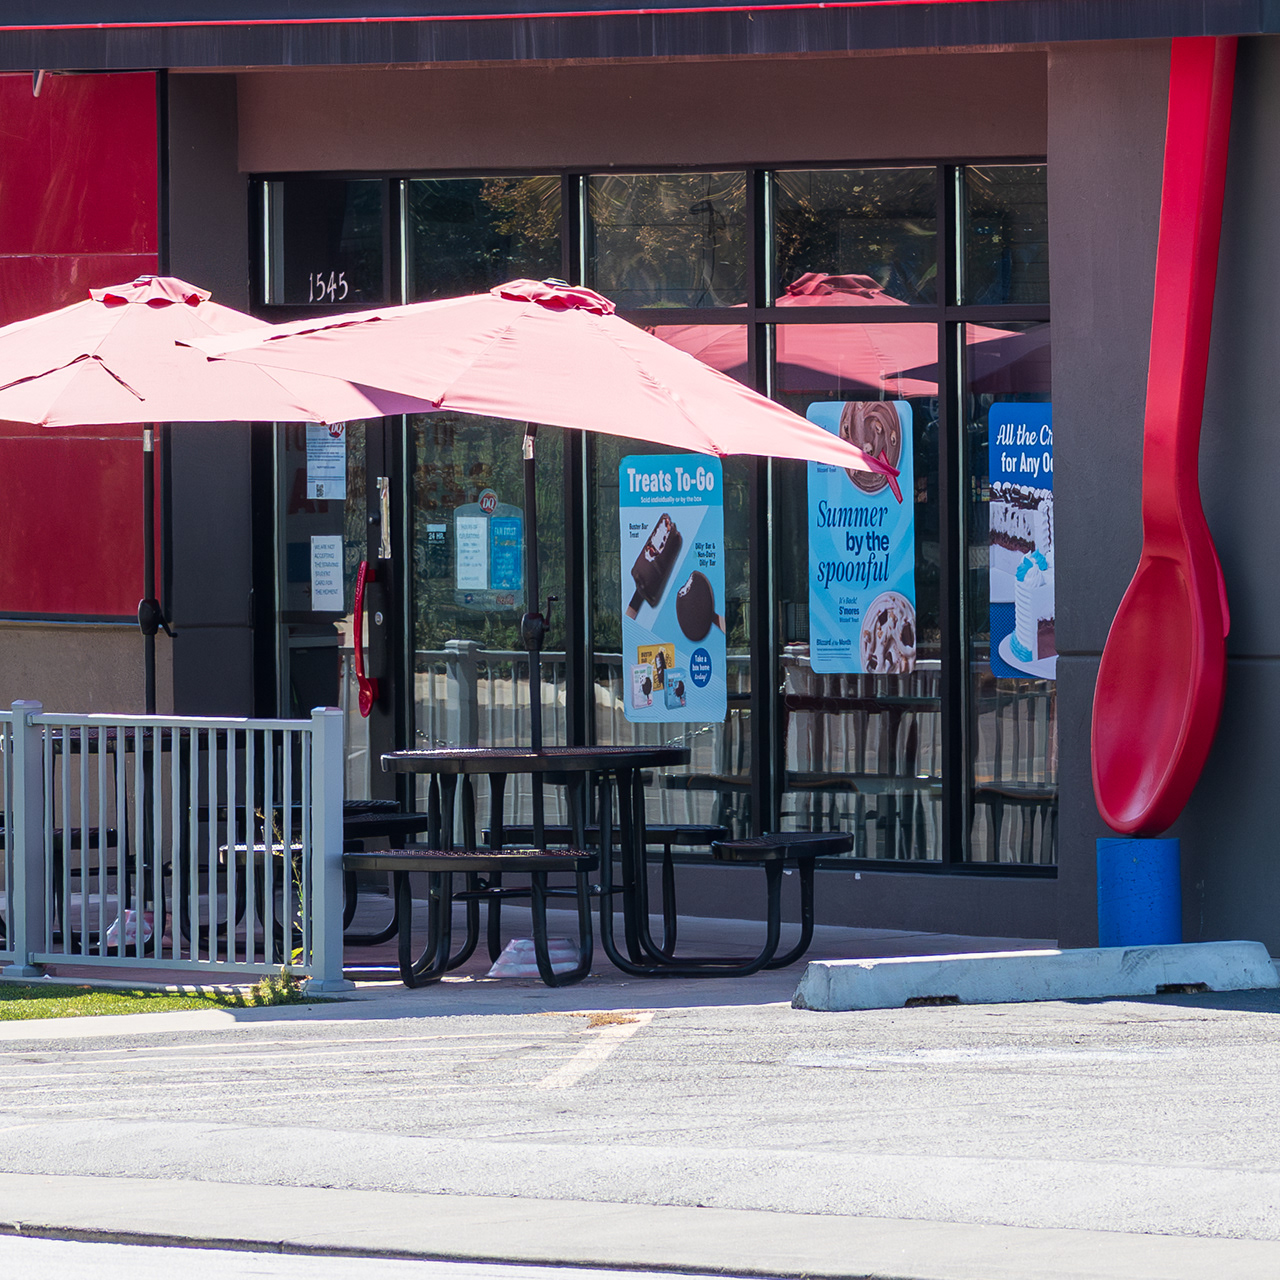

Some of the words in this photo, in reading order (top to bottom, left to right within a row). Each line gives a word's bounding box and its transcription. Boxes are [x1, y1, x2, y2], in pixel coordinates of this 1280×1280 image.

[308, 271, 349, 303] 1545
[996, 423, 1016, 445] All
[1016, 423, 1039, 445] the
[1001, 451, 1018, 473] for
[1019, 452, 1040, 478] Any
[627, 468, 672, 493] Treats
[674, 466, 715, 492] To-Go
[482, 497, 495, 510] DQ
[816, 499, 889, 528] Summer
[428, 532, 435, 540] 24
[435, 532, 445, 540] HR.
[695, 542, 704, 550] Dilly
[845, 531, 865, 557] by
[866, 531, 890, 552] the
[699, 559, 709, 568] Dilly
[816, 553, 890, 590] spoonful
[838, 606, 860, 615] S'mores
[694, 655, 704, 663] Take
